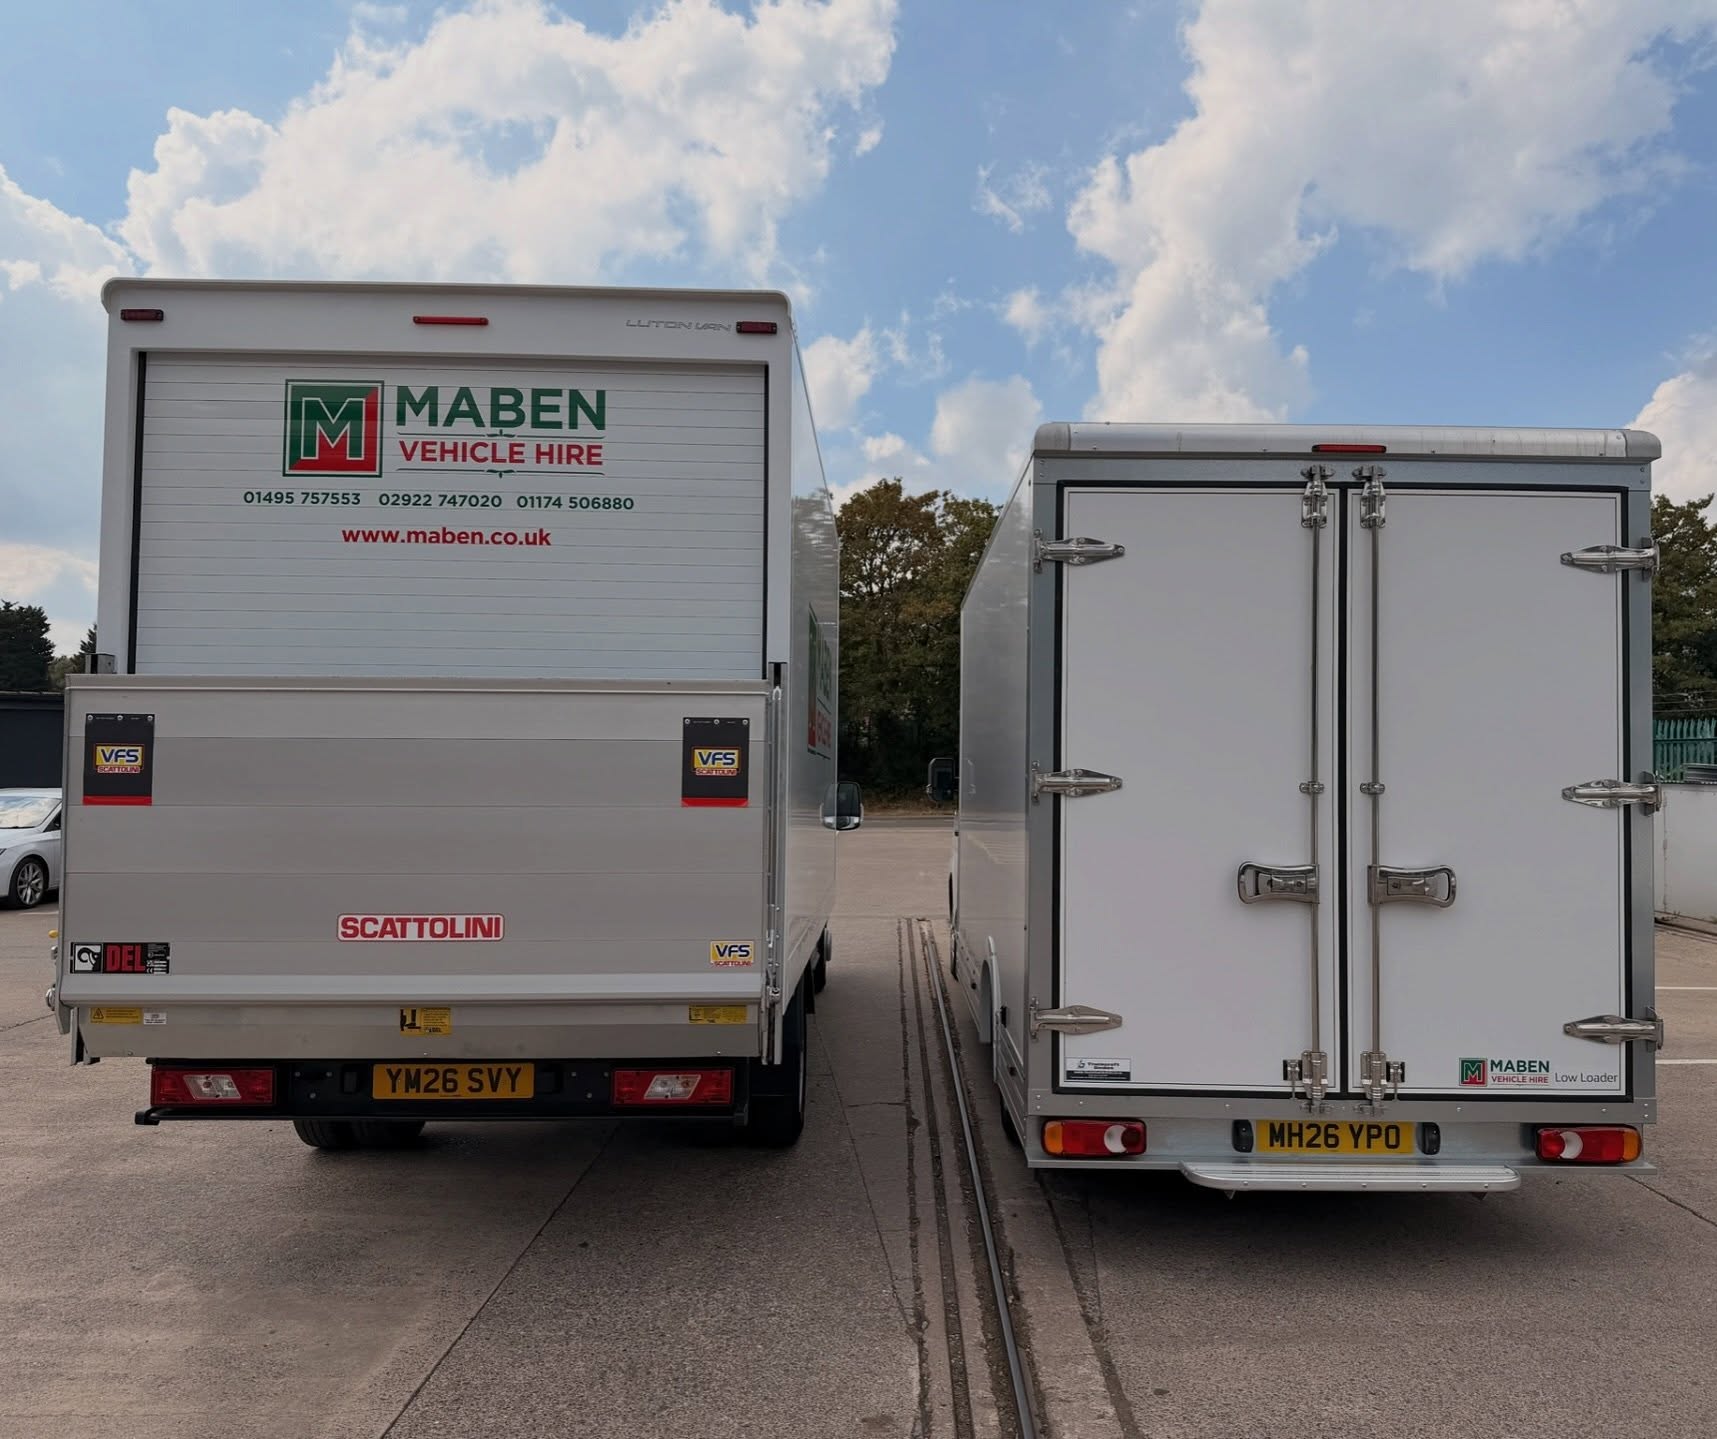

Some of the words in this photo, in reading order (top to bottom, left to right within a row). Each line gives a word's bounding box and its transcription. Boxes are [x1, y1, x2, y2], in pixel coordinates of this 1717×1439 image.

[625, 319, 692, 330] LUTON
[695, 322, 732, 331] VAN
[396, 385, 606, 431] MABEN
[301, 397, 366, 461] M
[399, 441, 525, 464] VEHICLE
[535, 443, 604, 466] HIRE
[243, 491, 295, 505] 01495
[300, 492, 361, 506] 757553
[378, 493, 432, 507] 02922
[438, 494, 503, 508] 747020
[516, 495, 563, 509] 01174
[568, 496, 634, 511] 506880
[341, 527, 551, 546] www.maben.co.uk
[101, 748, 139, 763] VFS
[698, 751, 736, 766] VFS
[340, 917, 501, 939] SCATTOLINI
[106, 944, 145, 972] DEL
[715, 944, 750, 957] VFS
[1490, 1059, 1550, 1073] MABEN
[386, 1068, 459, 1093] YM26
[467, 1067, 522, 1093] SVY
[1491, 1075, 1527, 1083] VEHICLE
[1529, 1076, 1549, 1084] HIRE
[1555, 1072, 1578, 1083] Low
[1580, 1073, 1618, 1083] Loader
[1269, 1122, 1340, 1149] MH26
[1349, 1124, 1400, 1149] YPO
